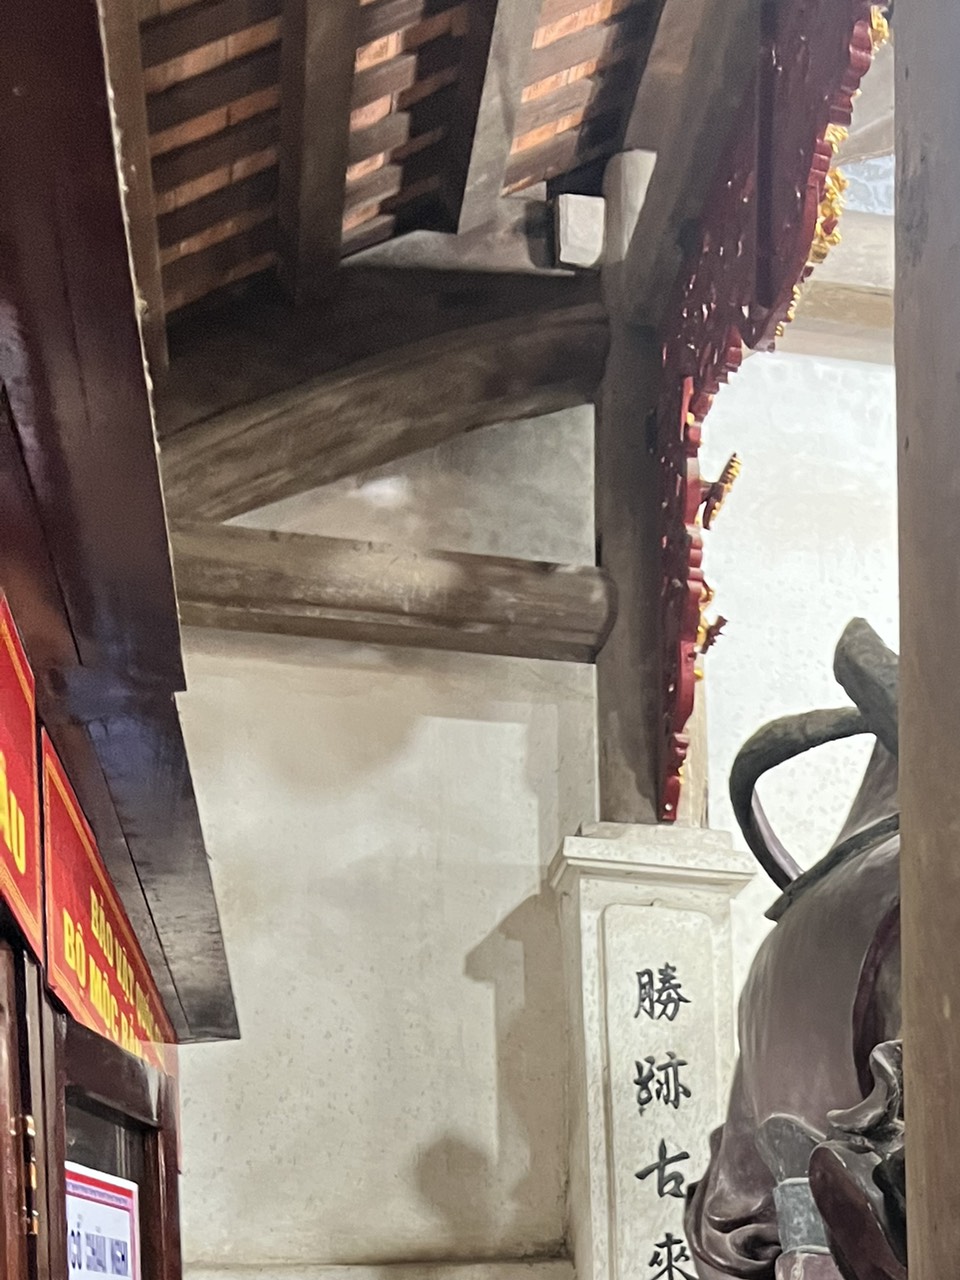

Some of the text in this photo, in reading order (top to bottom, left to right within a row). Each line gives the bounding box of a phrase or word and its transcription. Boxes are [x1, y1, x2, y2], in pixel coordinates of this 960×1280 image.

[63, 907, 86, 997] BỘ
[89, 954, 119, 1042] MỘC
[90, 886, 135, 1006] BẢO VẬT
